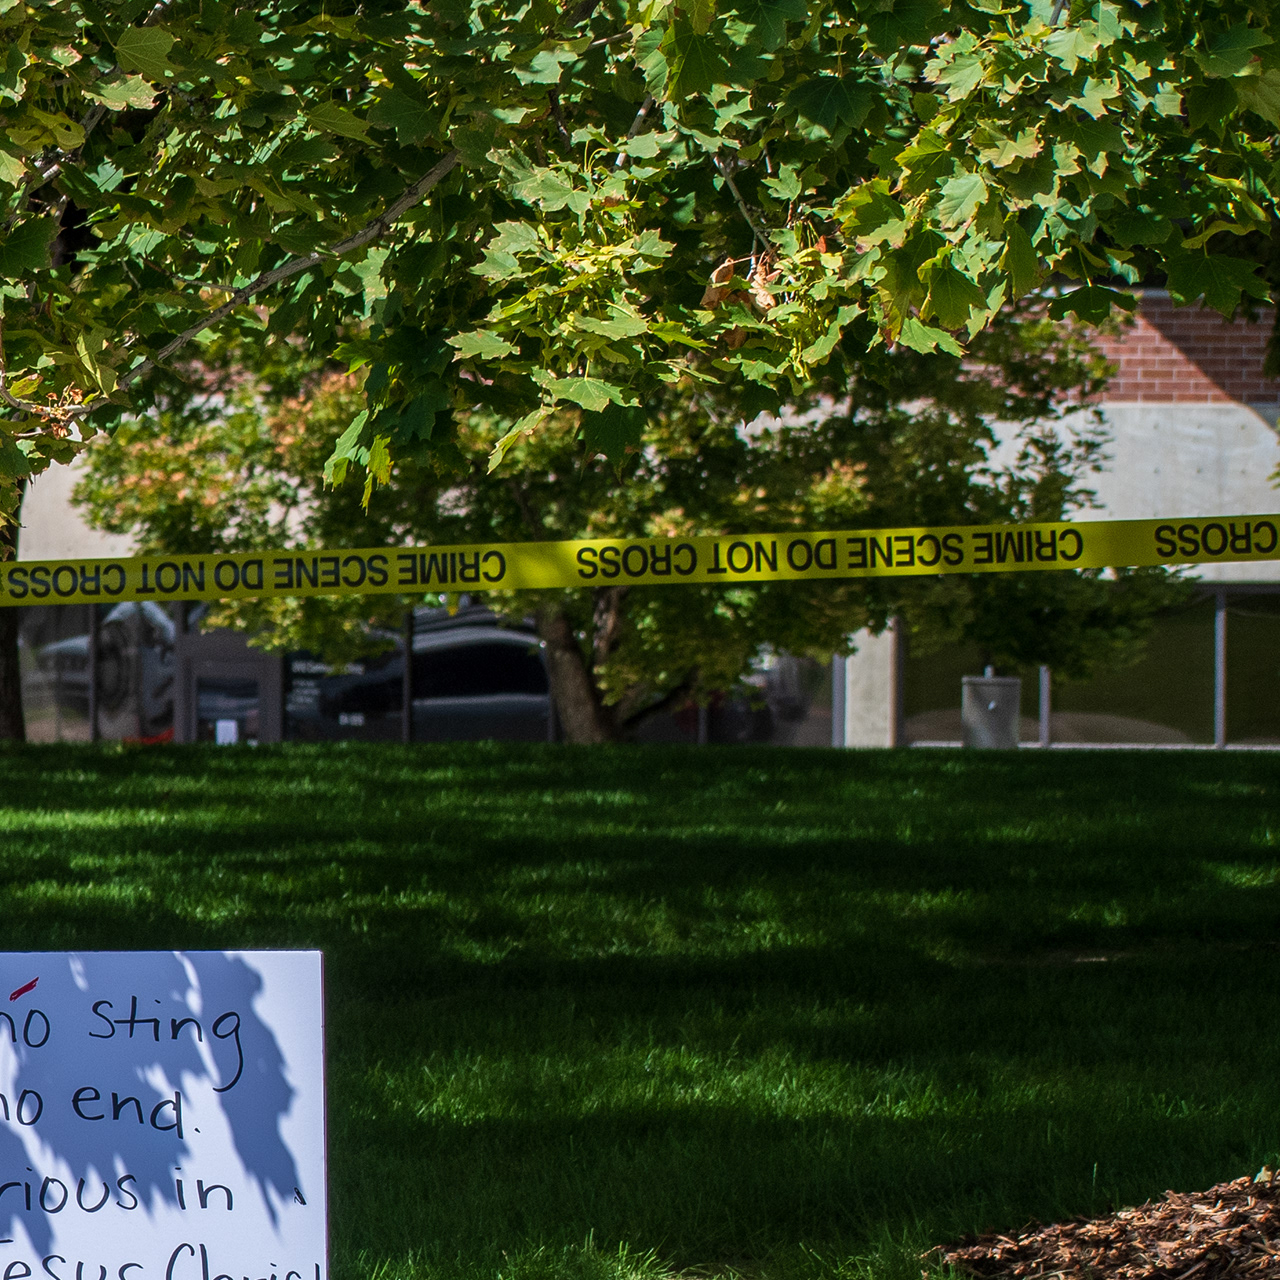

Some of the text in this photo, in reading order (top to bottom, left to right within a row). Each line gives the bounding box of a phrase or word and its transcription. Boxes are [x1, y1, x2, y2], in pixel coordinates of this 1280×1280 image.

[576, 528, 1084, 580] CRIME SCENE DO NOT CROSS
[1153, 520, 1278, 558] CROSS
[7, 550, 507, 599] CRIME SCENE DO NOT CROSS
[90, 994, 244, 1092] sting
[72, 1085, 201, 1140] end.
[175, 1166, 234, 1212] in
